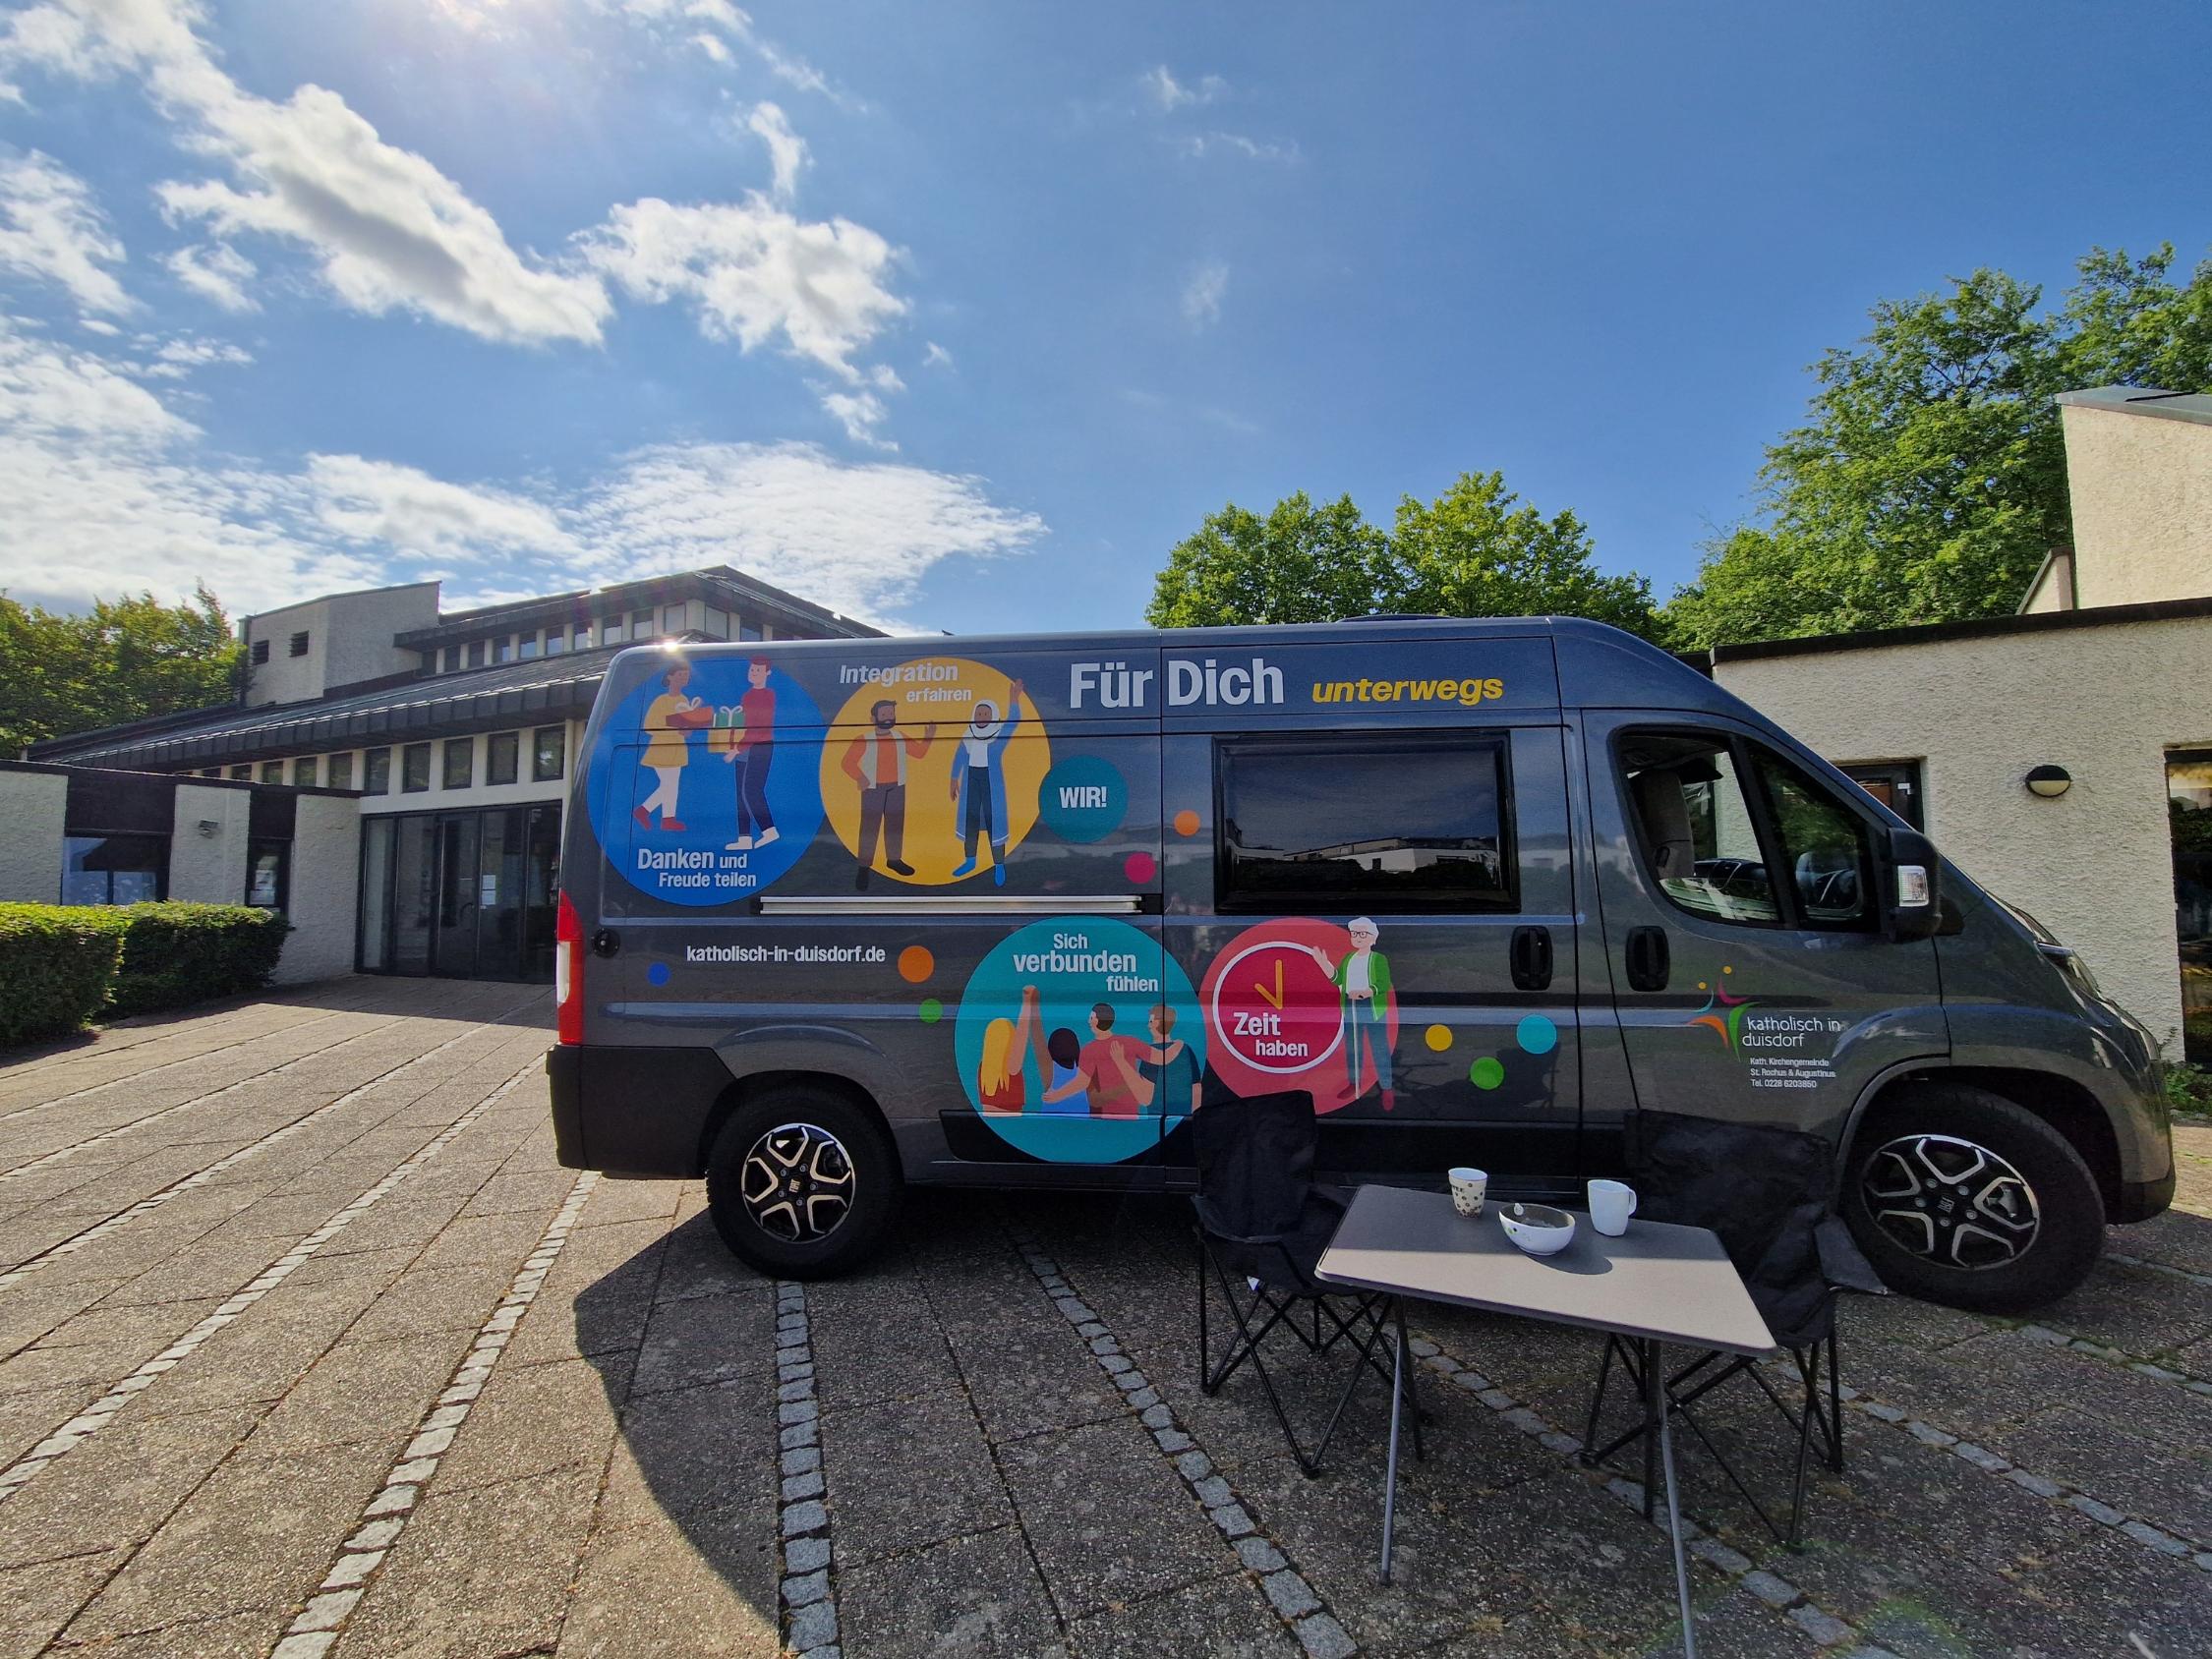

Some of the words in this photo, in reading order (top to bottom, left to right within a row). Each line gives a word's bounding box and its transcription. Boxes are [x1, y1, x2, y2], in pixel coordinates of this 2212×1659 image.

[840, 663, 958, 686] Integration
[1070, 662, 1154, 709] Für
[1168, 658, 1284, 706] Dich
[1311, 678, 1503, 706] unterwegs
[905, 688, 972, 703] erfahren
[1060, 786, 1108, 809] WIR!
[637, 848, 714, 870] Danken
[719, 853, 747, 869] und
[659, 871, 710, 887] Freude
[714, 871, 757, 887] teilen
[1052, 933, 1087, 950] Sich
[686, 944, 886, 964] katholisch-in-duisdorf.de
[1013, 950, 1136, 974] verbunden
[1106, 975, 1159, 994] fühlen
[1233, 1011, 1281, 1037] Zeit
[1747, 1016, 1823, 1031] katholisch
[1828, 1017, 1840, 1032] in
[1255, 1039, 1309, 1058] haben
[1742, 1033, 1805, 1047] duisdorf
[1750, 1058, 1768, 1066] Kath.
[1769, 1058, 1830, 1068] Kirchengemeinde
[1750, 1068, 1760, 1077] St.
[1761, 1068, 1787, 1077] Rochus
[1787, 1068, 1794, 1077] &
[1794, 1068, 1835, 1079] Augustinus
[1751, 1079, 1763, 1088] Tel.
[1764, 1079, 1782, 1088] 0228
